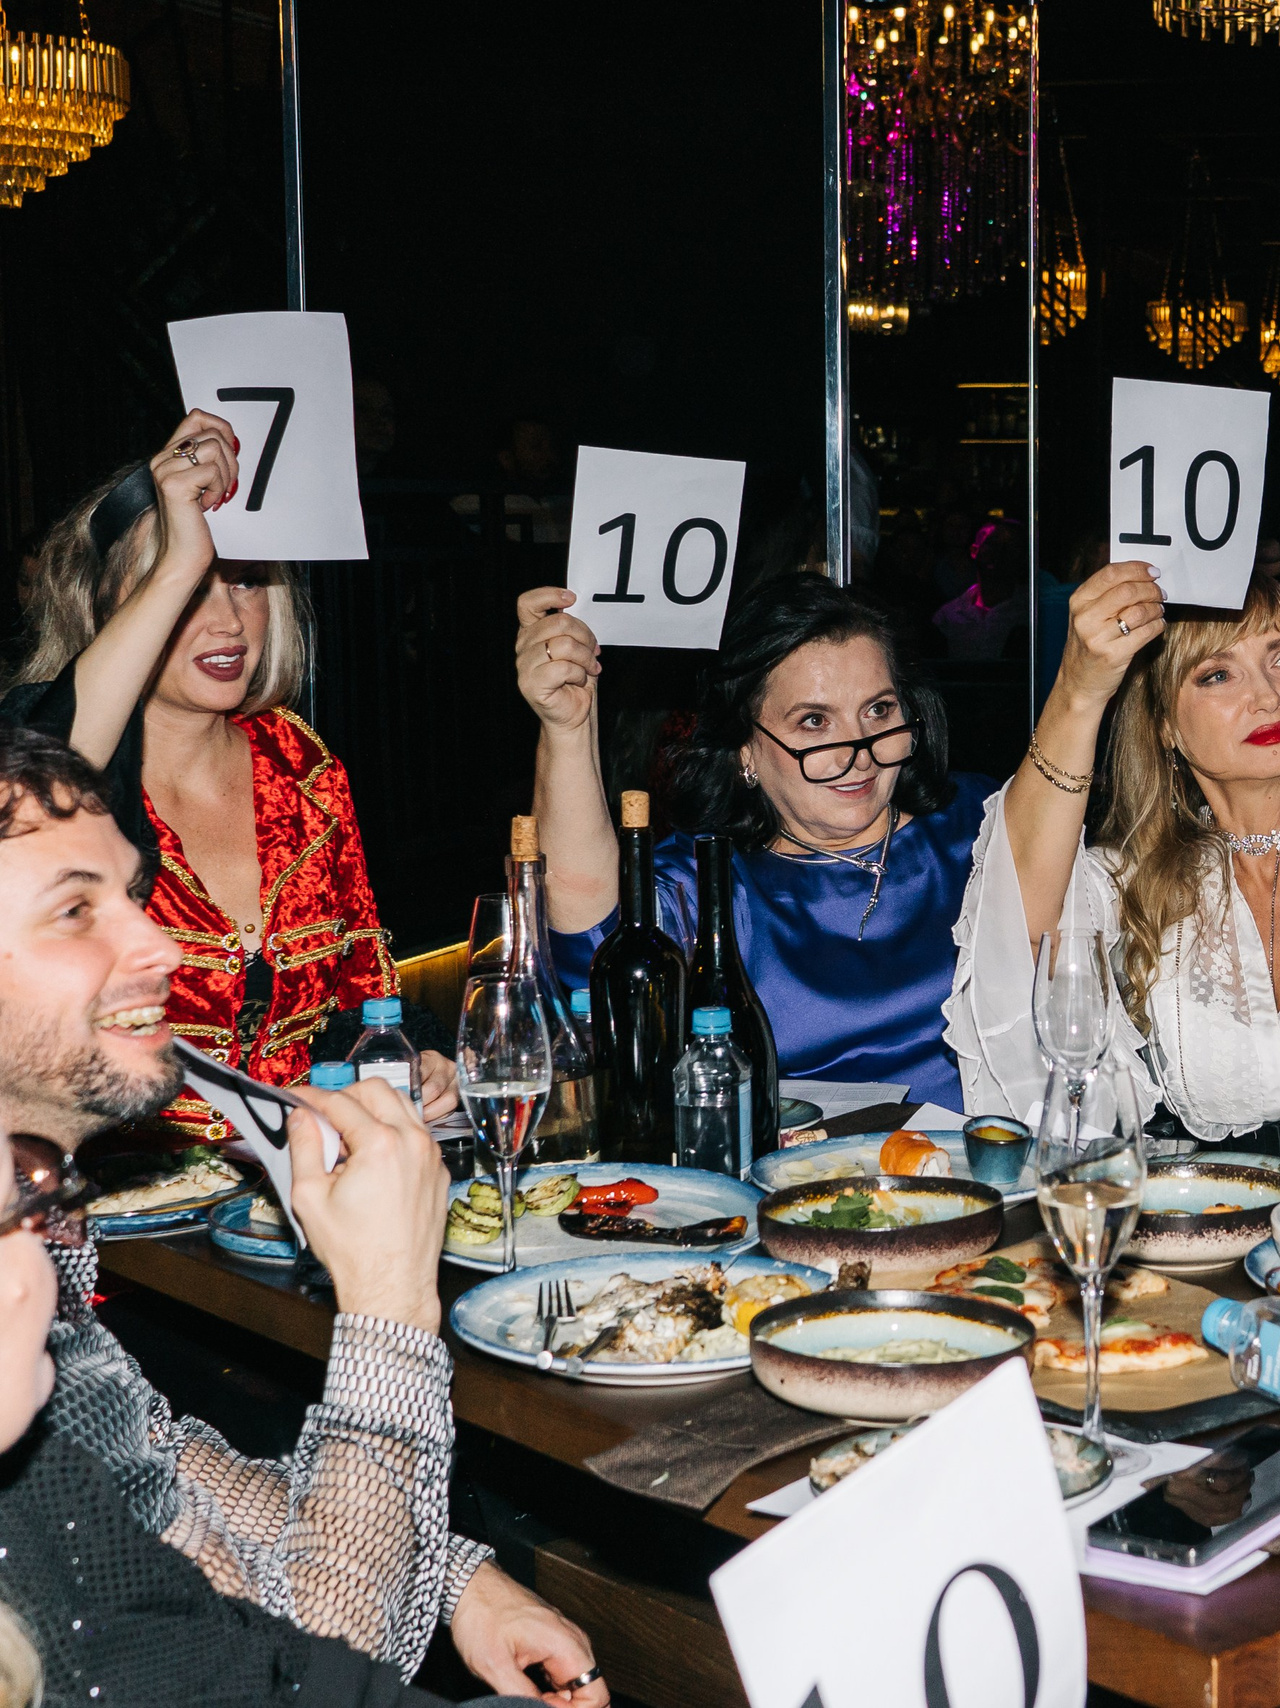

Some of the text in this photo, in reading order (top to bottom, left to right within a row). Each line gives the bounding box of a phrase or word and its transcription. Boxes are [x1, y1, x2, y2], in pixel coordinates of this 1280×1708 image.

[216, 386, 296, 512] 7
[1118, 444, 1241, 552] 10
[591, 512, 729, 606] 10
[801, 1563, 1040, 1708] 0
